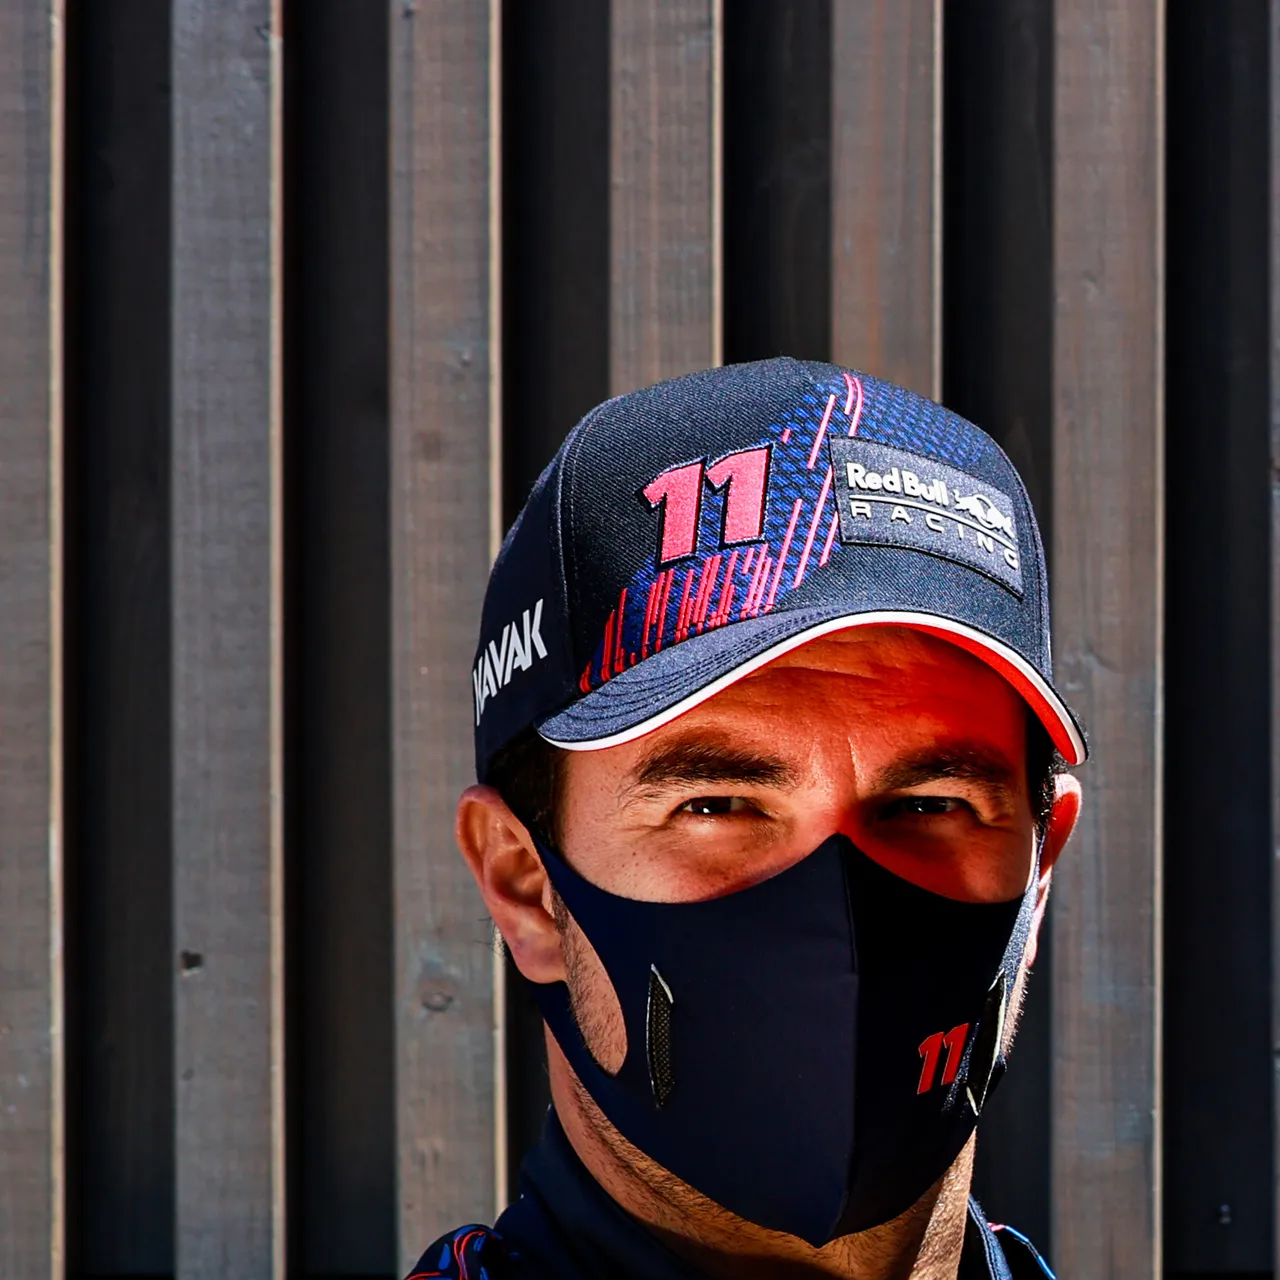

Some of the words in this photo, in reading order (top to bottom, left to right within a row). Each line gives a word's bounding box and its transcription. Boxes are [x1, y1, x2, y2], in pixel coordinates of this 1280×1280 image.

[642, 446, 771, 562] 11
[847, 463, 900, 493] Red
[901, 471, 949, 505] Bull
[851, 501, 1018, 569] RACING
[917, 1023, 970, 1095] 11
